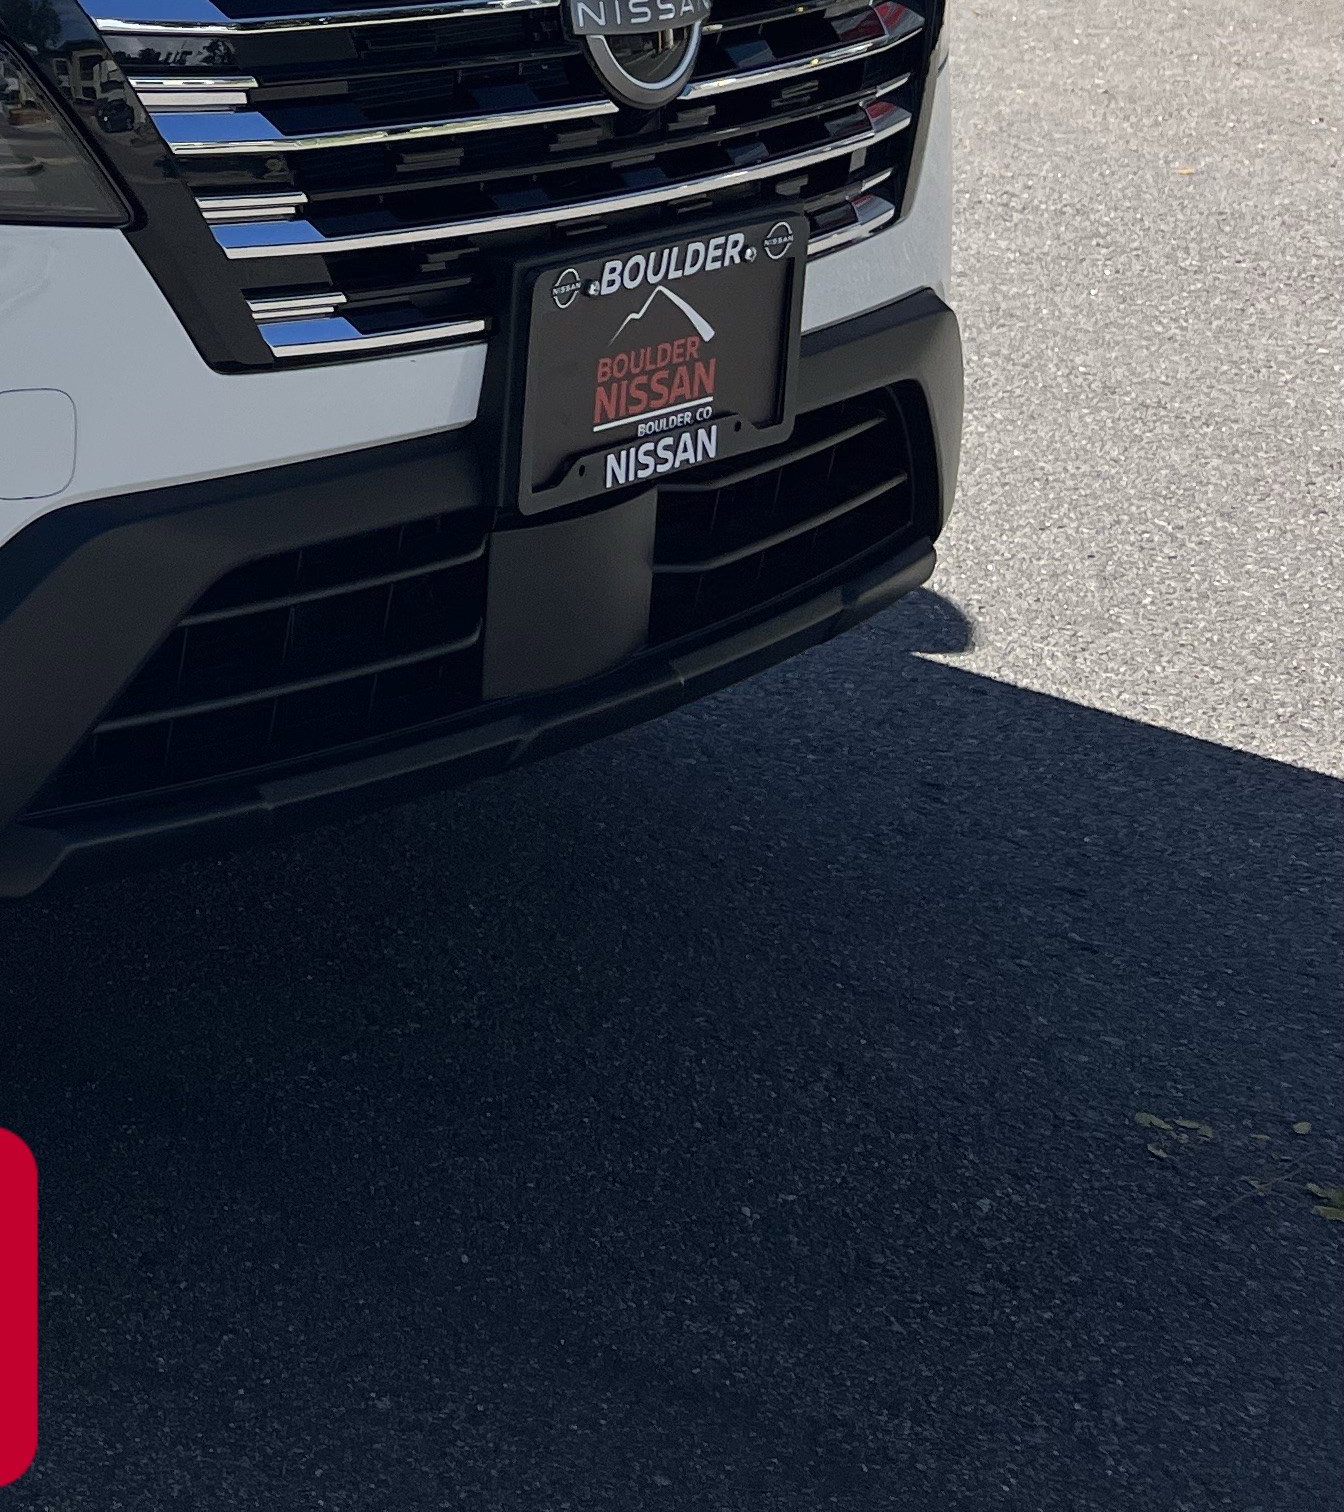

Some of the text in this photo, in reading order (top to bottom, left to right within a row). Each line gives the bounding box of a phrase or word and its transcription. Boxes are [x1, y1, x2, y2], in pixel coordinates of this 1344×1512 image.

[600, 232, 746, 296] BOULDER
[593, 357, 717, 424] NISSAN
[597, 334, 701, 384] BOULDER
[695, 405, 713, 421] CO
[605, 425, 718, 489] NISSAN
